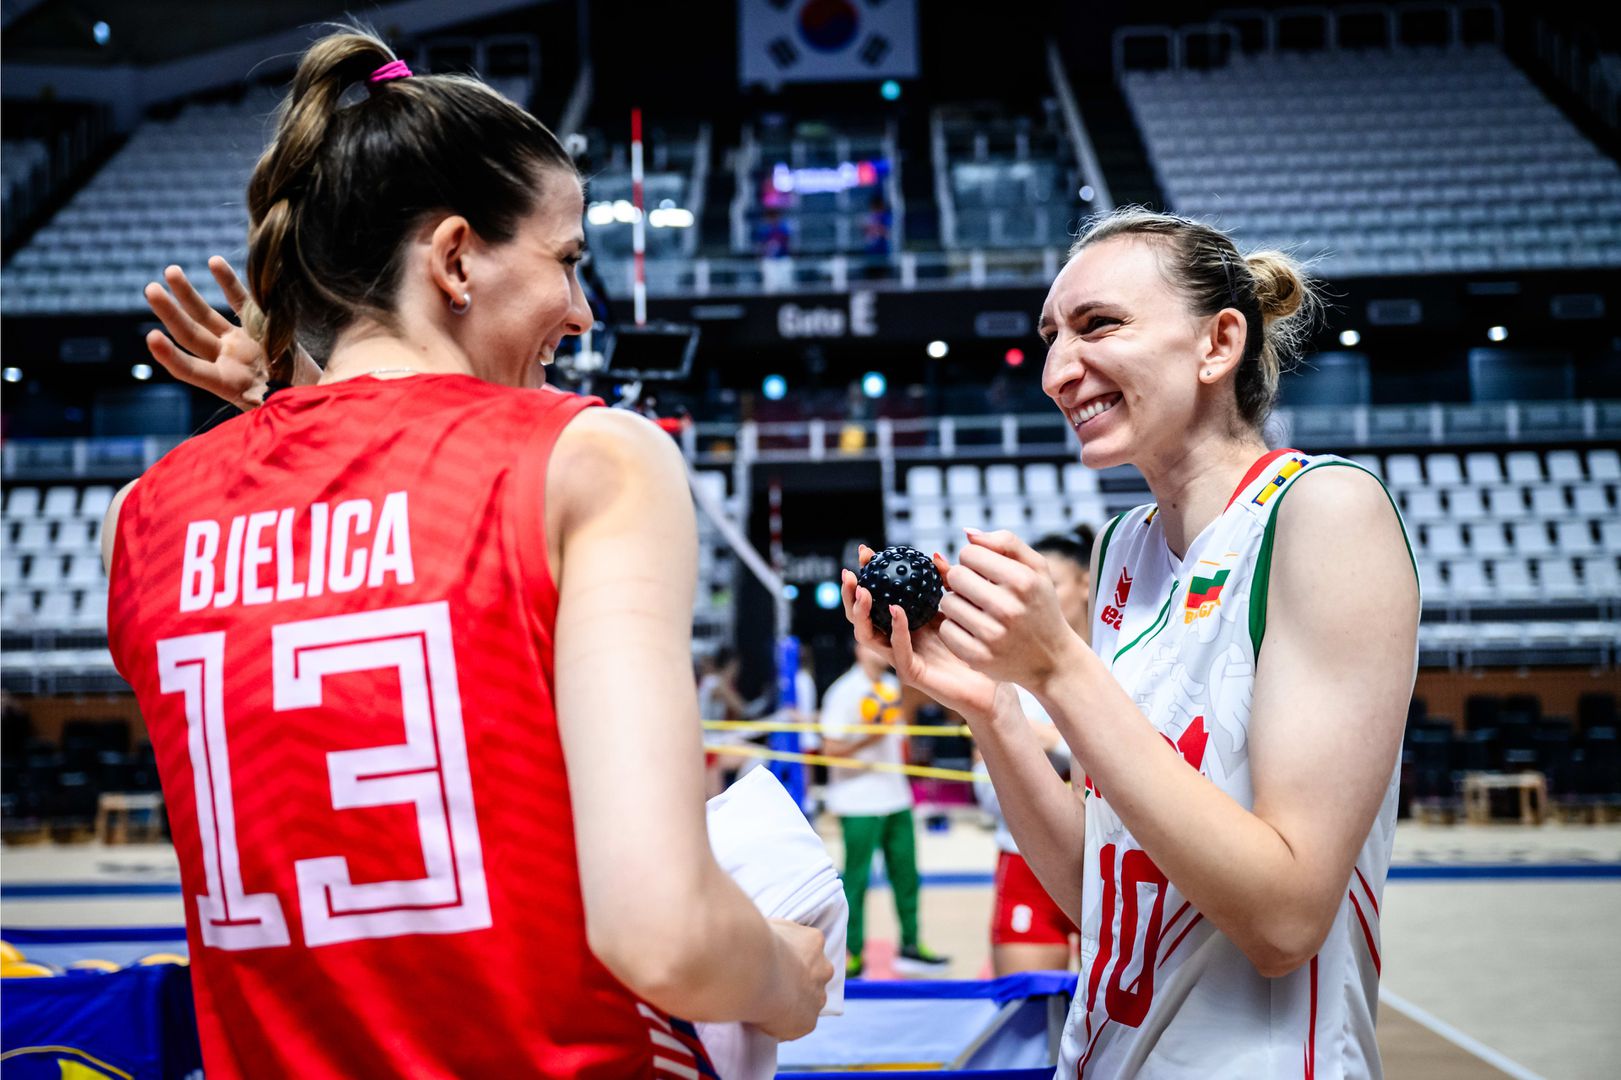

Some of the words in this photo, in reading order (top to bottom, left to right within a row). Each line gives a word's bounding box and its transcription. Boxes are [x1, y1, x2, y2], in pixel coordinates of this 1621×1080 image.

[849, 288, 880, 337] E
[180, 491, 414, 613] BJELICA
[157, 601, 492, 951] 13
[1086, 843, 1169, 1028] 10
